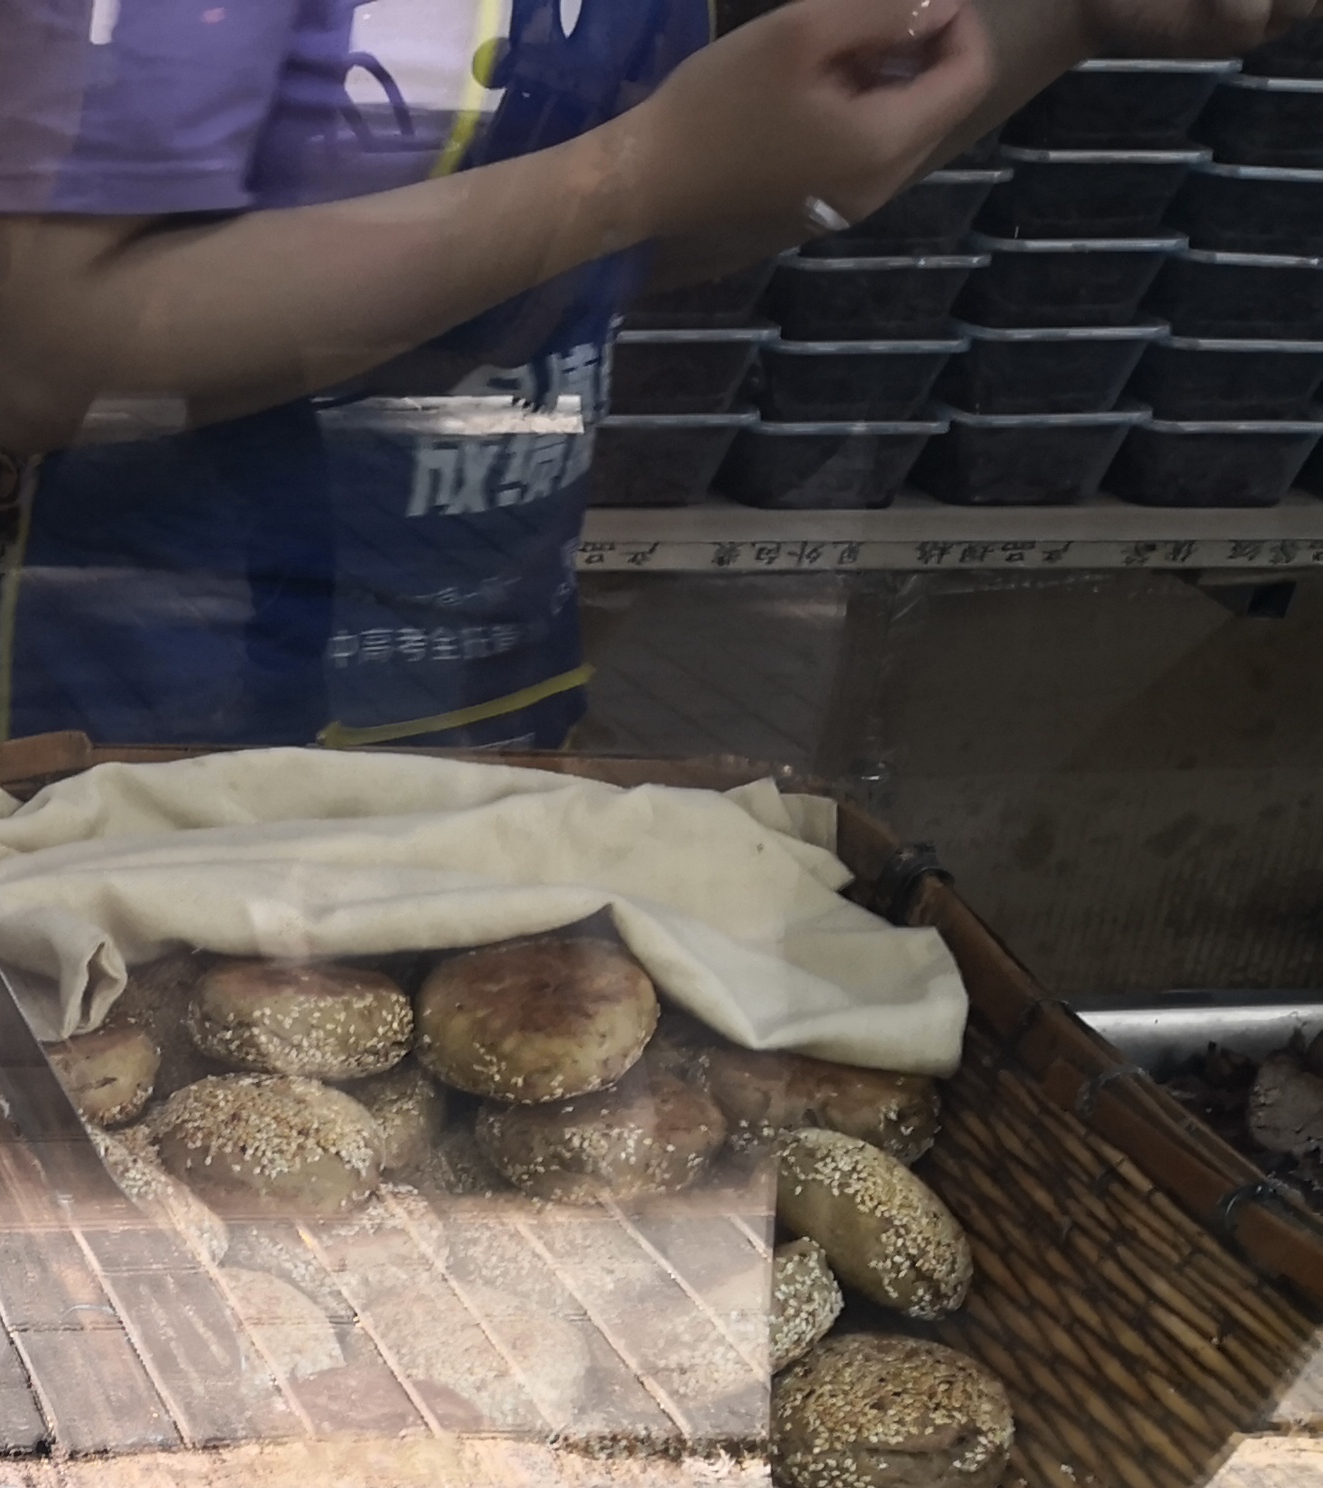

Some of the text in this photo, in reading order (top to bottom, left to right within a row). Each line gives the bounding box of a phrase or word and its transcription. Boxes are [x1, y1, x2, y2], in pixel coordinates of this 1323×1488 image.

[579, 540, 661, 566] 产品
[711, 540, 864, 566] 见外包装
